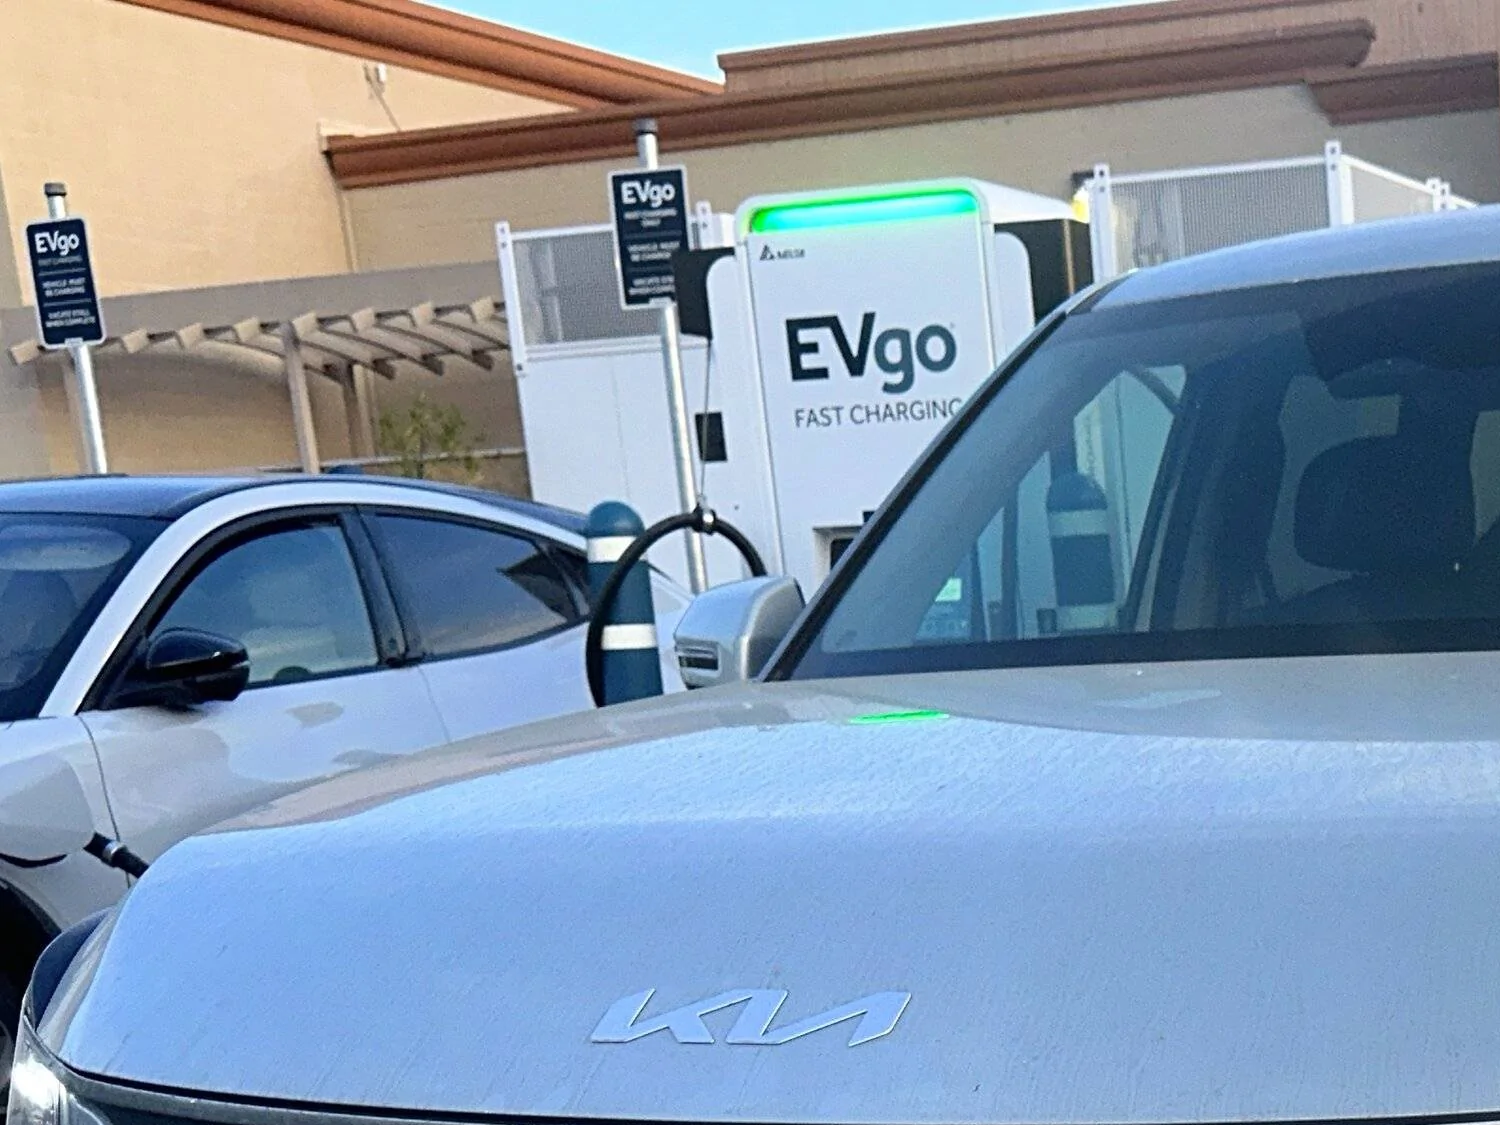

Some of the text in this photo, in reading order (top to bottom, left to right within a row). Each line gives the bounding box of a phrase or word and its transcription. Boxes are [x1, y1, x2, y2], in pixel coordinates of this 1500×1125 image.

[621, 179, 675, 208] EVgo
[34, 230, 80, 256] EVgo
[785, 312, 957, 394] EVgo
[795, 406, 845, 429] FAST
